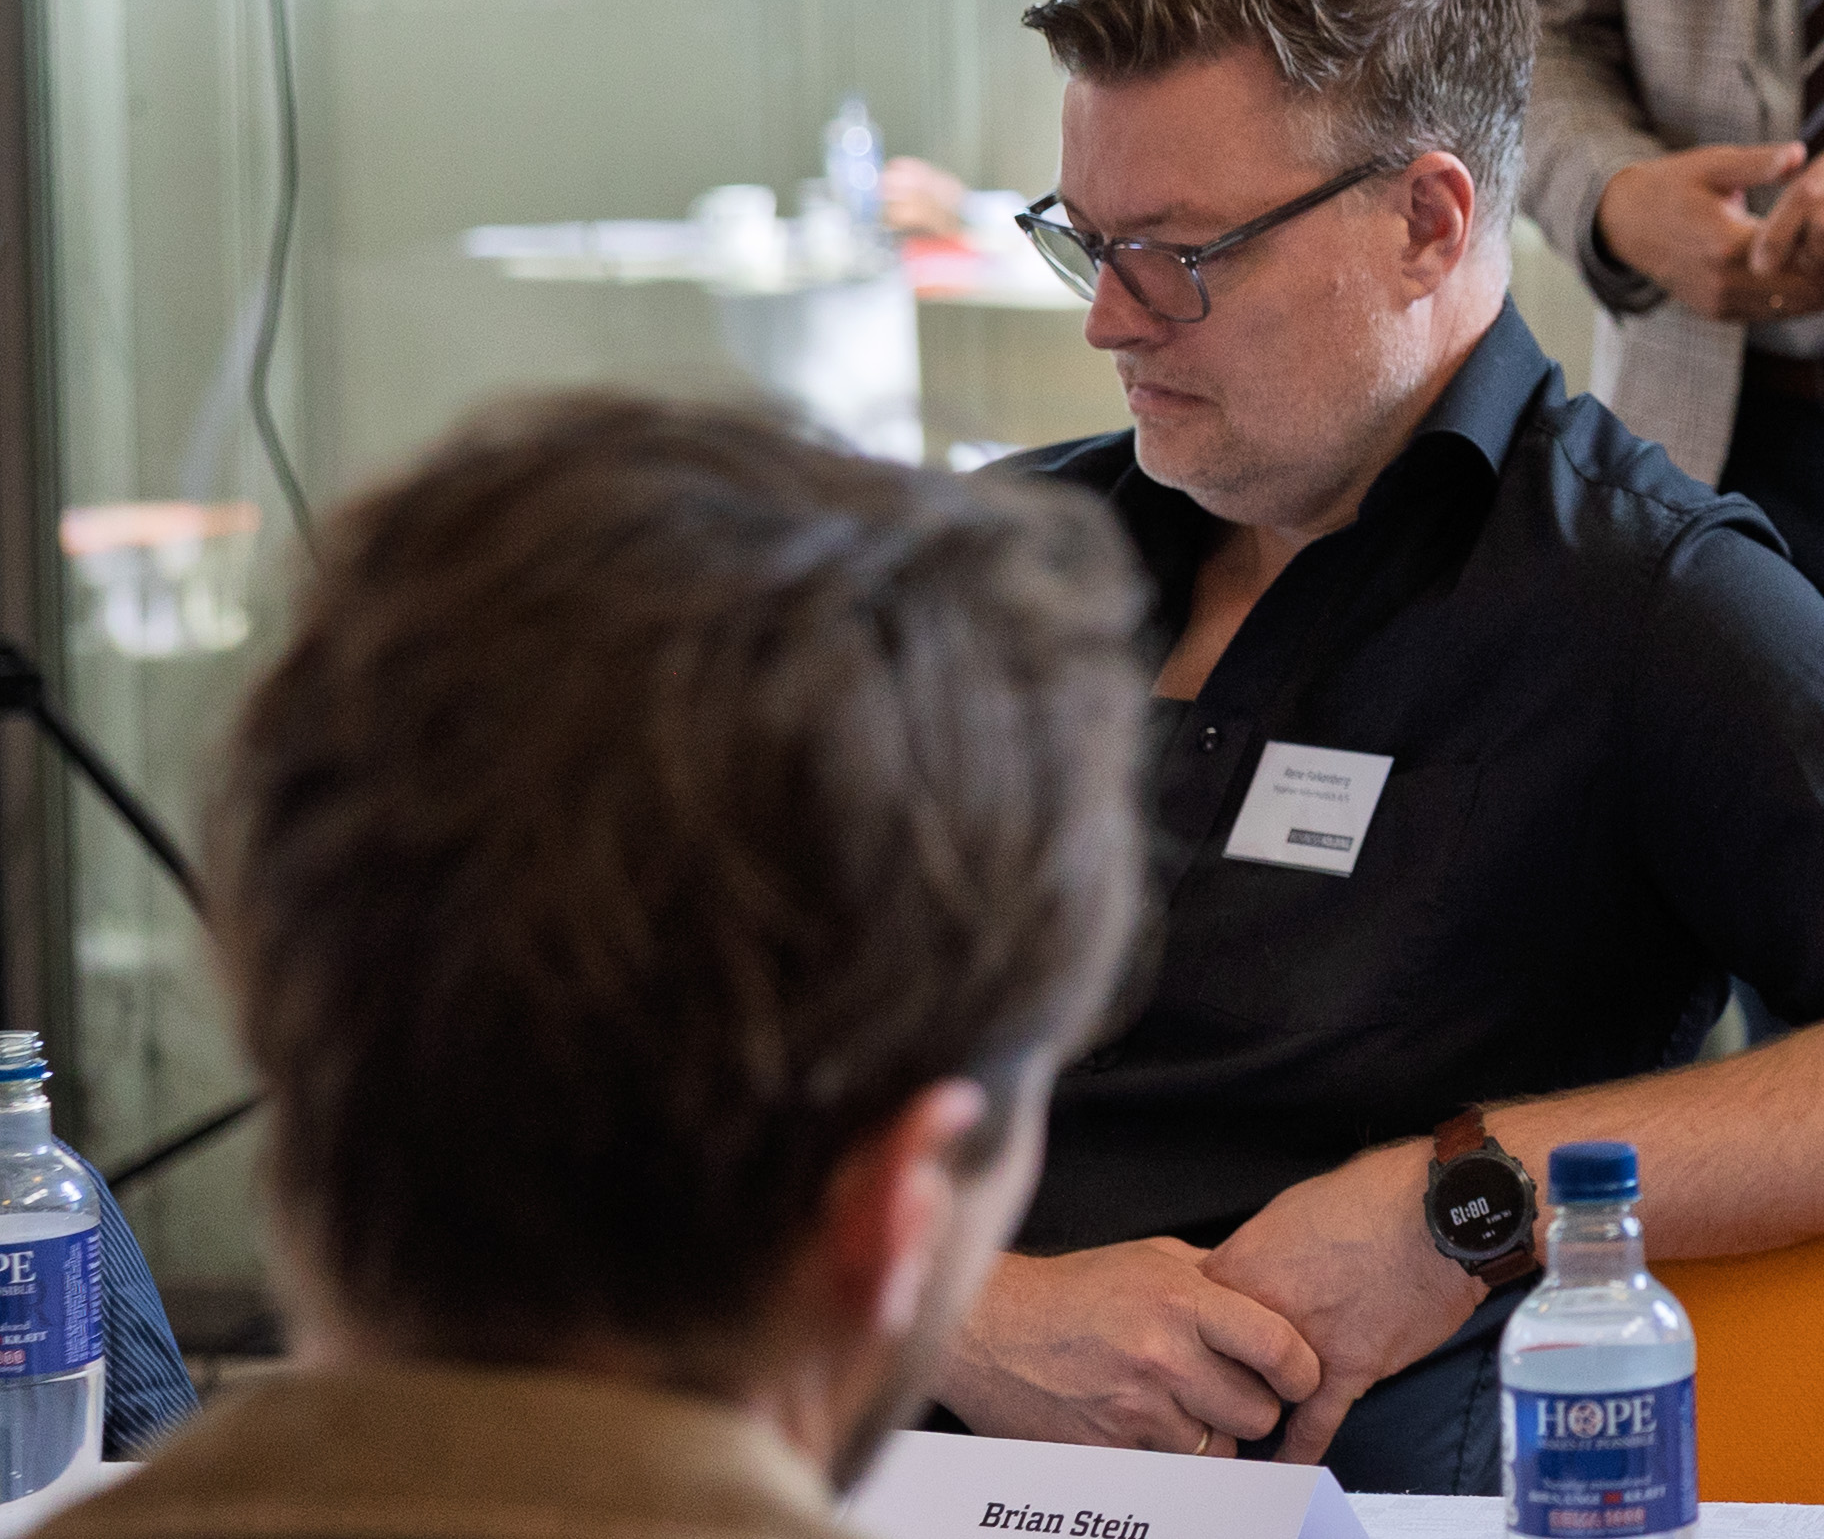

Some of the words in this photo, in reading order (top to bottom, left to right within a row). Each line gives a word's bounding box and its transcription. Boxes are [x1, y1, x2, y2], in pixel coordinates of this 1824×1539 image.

[1449, 1196, 1490, 1226] 08:13
[1536, 1393, 1658, 1439] HOPE
[979, 1502, 1065, 1533] Brian
[1069, 1510, 1150, 1539] Stein
